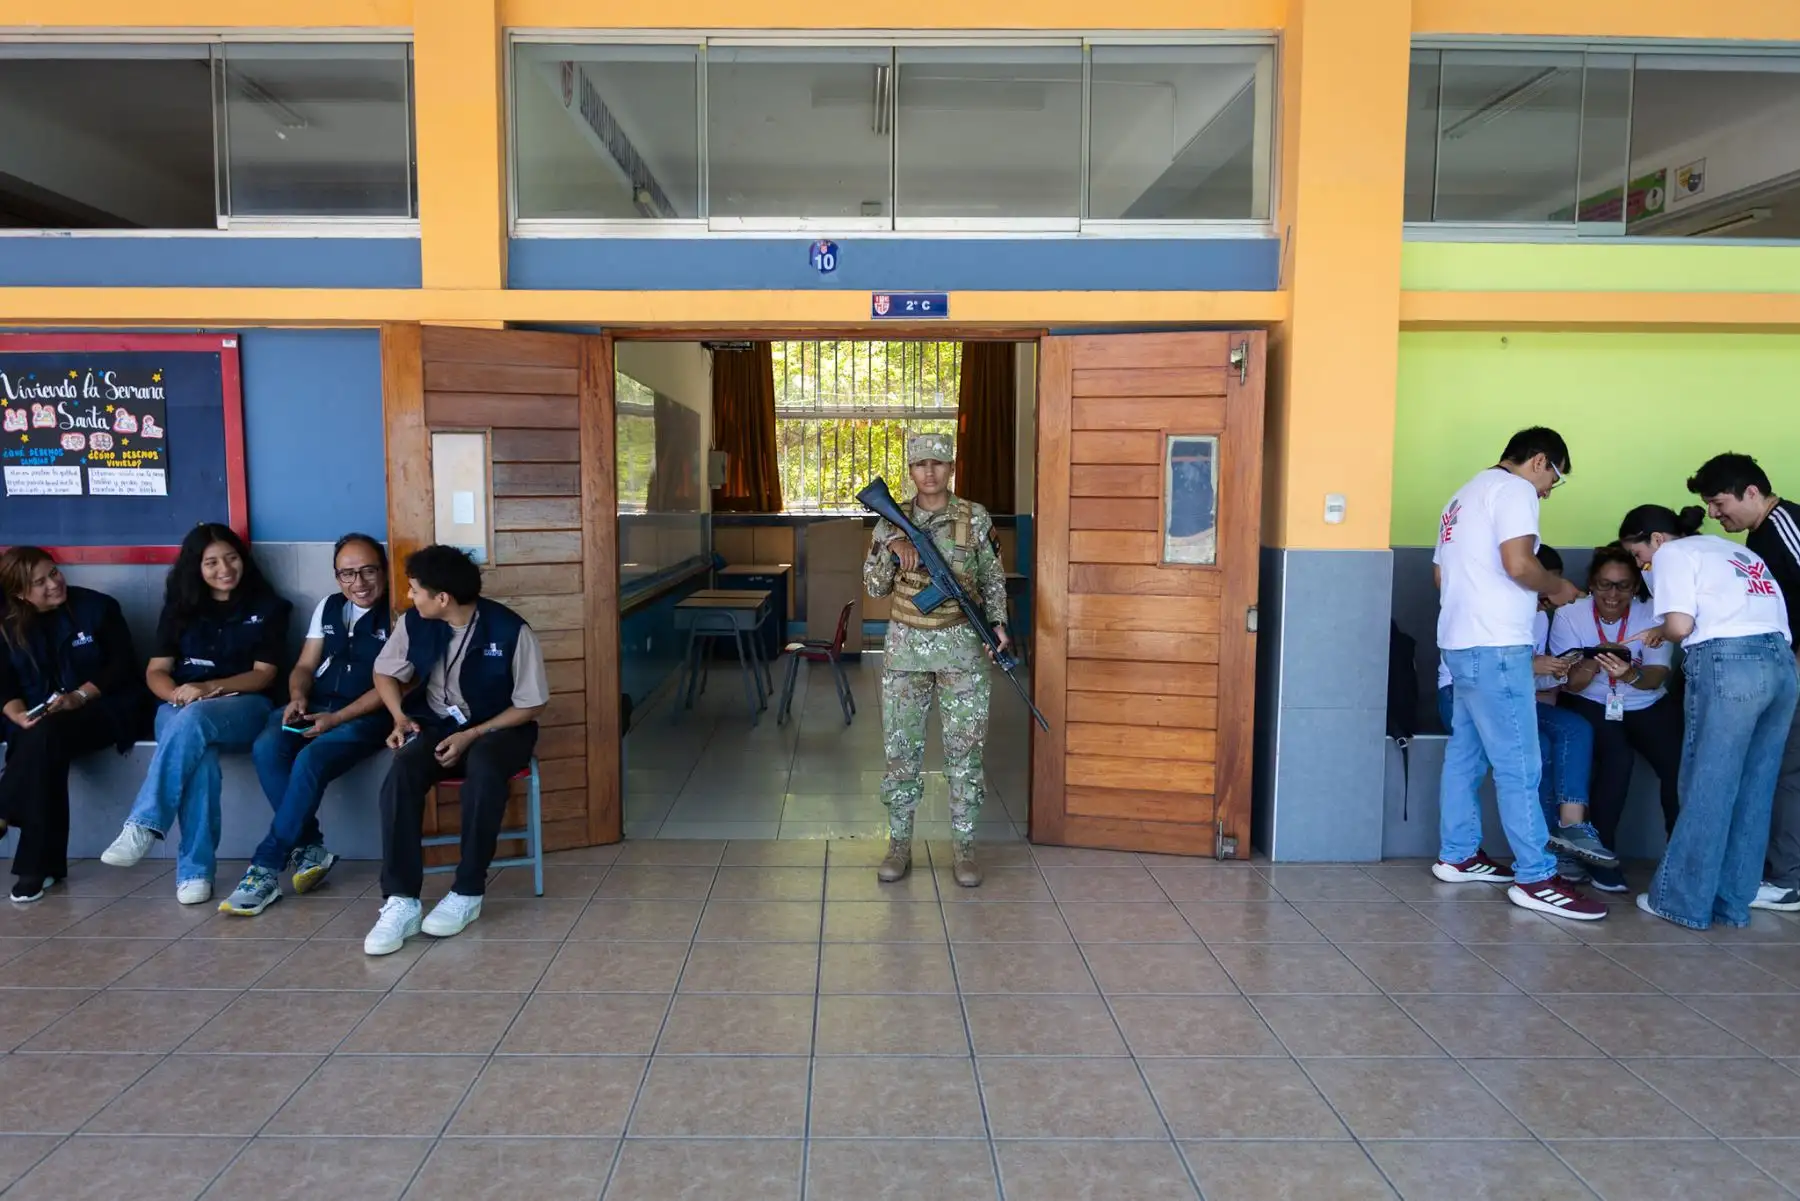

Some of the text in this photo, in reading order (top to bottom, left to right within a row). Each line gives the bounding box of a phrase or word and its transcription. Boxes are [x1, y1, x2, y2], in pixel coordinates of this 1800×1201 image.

[815, 254, 834, 270] 10
[921, 300, 930, 310] C
[0, 371, 165, 400] Viviendo la Semana
[57, 401, 111, 430] Santa
[122, 450, 159, 460] DEBEMOS
[1748, 579, 1776, 594] JNE
